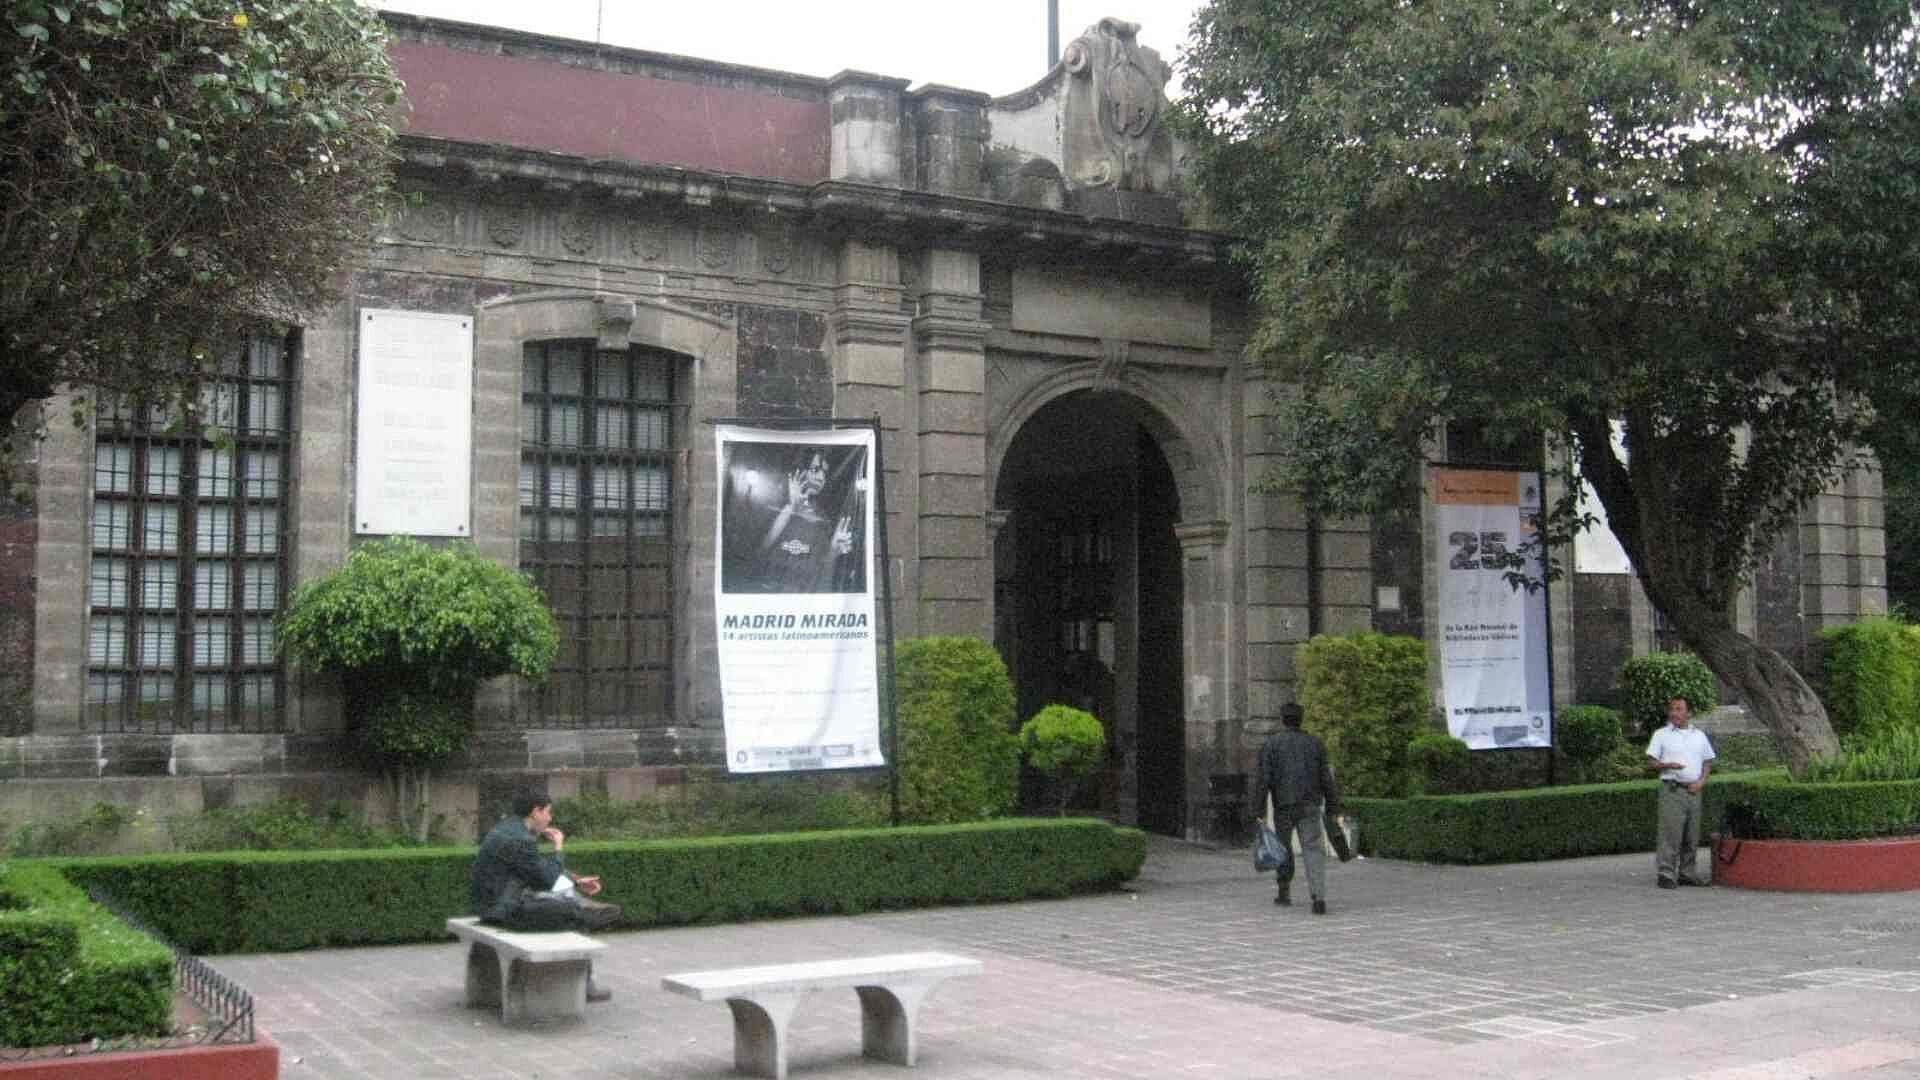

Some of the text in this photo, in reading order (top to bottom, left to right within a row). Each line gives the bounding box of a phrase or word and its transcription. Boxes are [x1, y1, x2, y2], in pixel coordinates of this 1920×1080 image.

[1449, 531, 1508, 570] 25
[723, 612, 868, 629] MADRID MIRADA
[723, 631, 734, 641] 14
[736, 631, 779, 641] artistas
